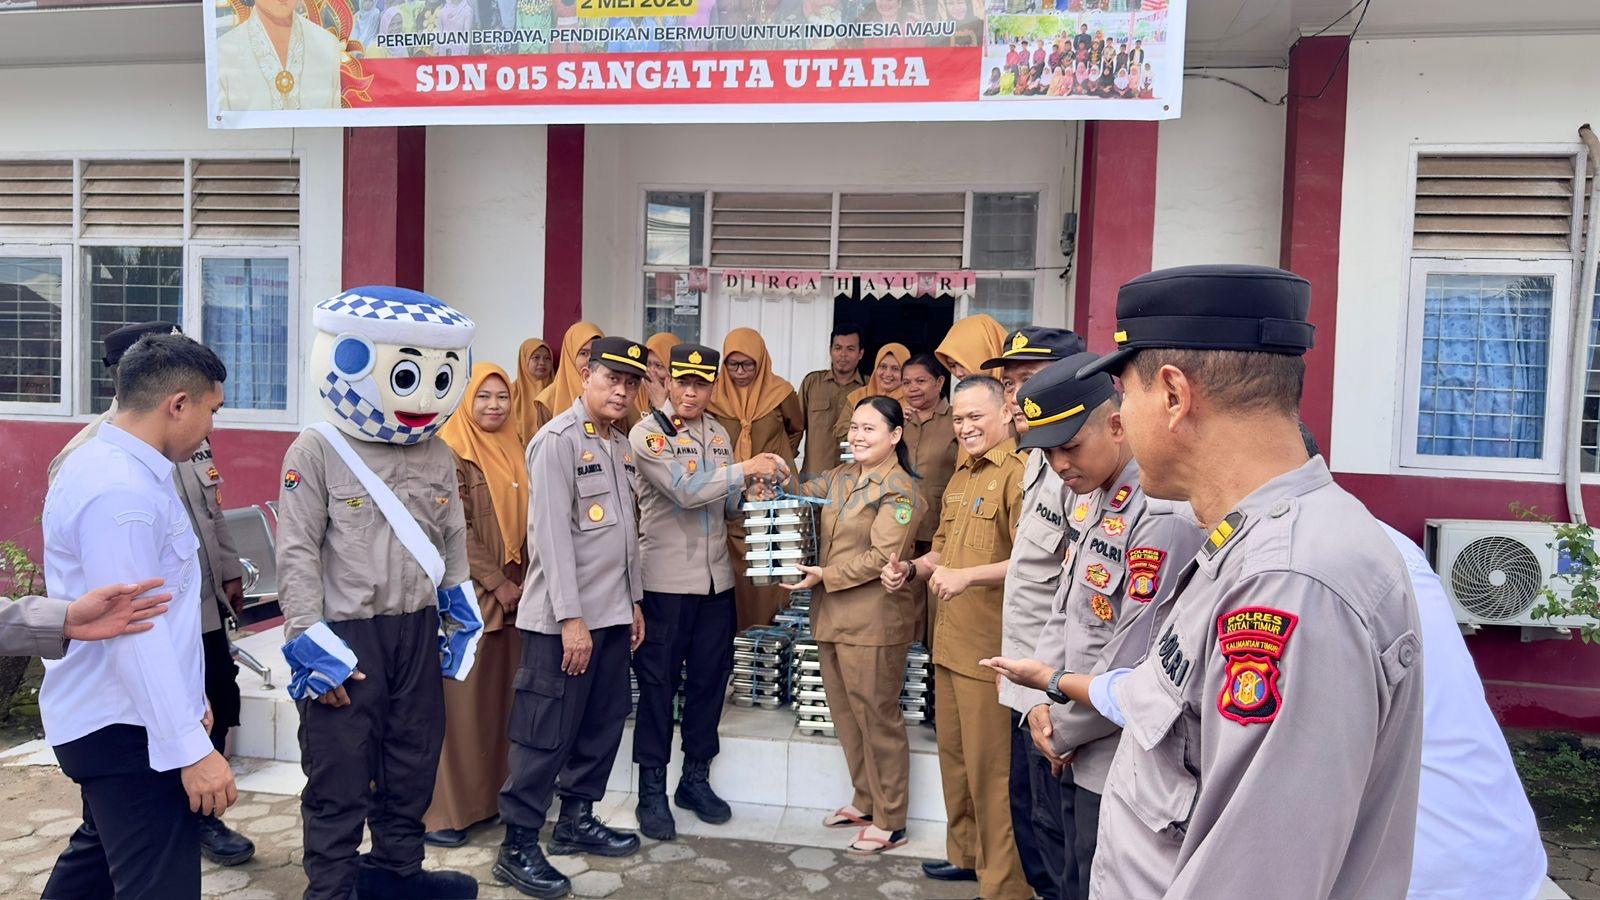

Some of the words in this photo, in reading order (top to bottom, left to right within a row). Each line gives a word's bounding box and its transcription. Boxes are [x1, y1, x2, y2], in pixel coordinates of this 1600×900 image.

[377, 31, 468, 47] PEREMPUAN
[472, 30, 546, 45] BERDAYA,
[550, 27, 650, 43] PENDIDIKAN
[654, 26, 736, 41] BERMUTU
[741, 25, 801, 40] UNTUK
[805, 23, 901, 38] INDONESIA
[906, 22, 955, 37] MAJU
[416, 63, 487, 92] SDN
[496, 66, 547, 91] 015
[557, 59, 774, 90] SANGATTA
[783, 56, 930, 88] UTARA
[941, 277, 969, 291] RI
[1036, 502, 1062, 526] POLRI
[1090, 538, 1122, 562] POLRI
[1227, 621, 1250, 634] KUTAI
[1253, 622, 1280, 634] TIMUR
[1228, 612, 1282, 625] POLRES
[1159, 623, 1190, 687] POLRI
